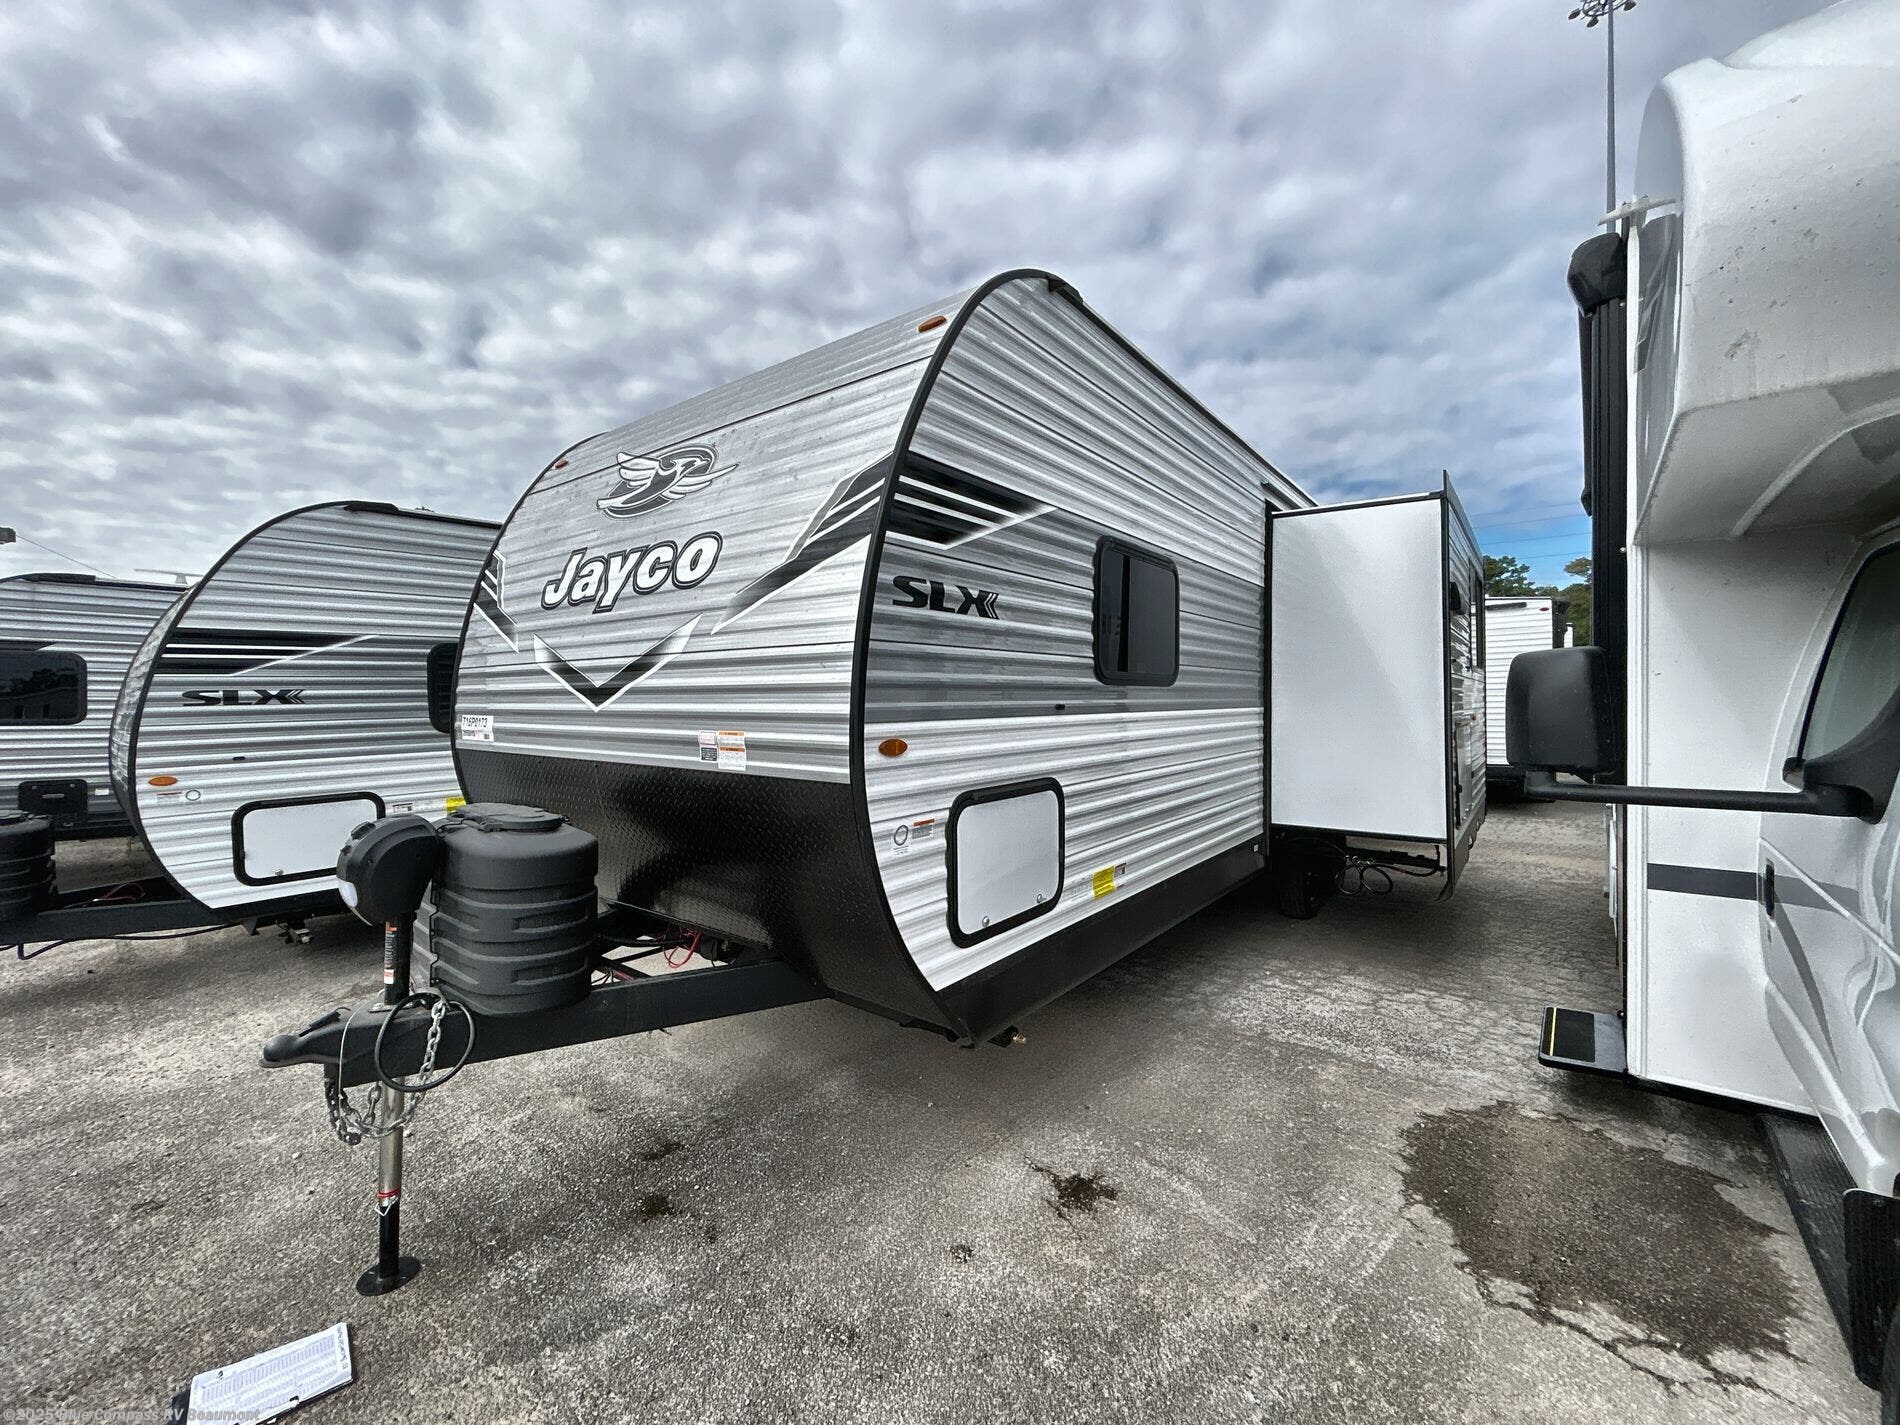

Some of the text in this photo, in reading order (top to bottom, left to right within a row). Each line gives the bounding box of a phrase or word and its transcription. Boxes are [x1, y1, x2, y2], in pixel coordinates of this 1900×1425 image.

[541, 531, 723, 614] Jayco
[892, 575, 999, 620] SLX
[182, 689, 306, 706] SLX
